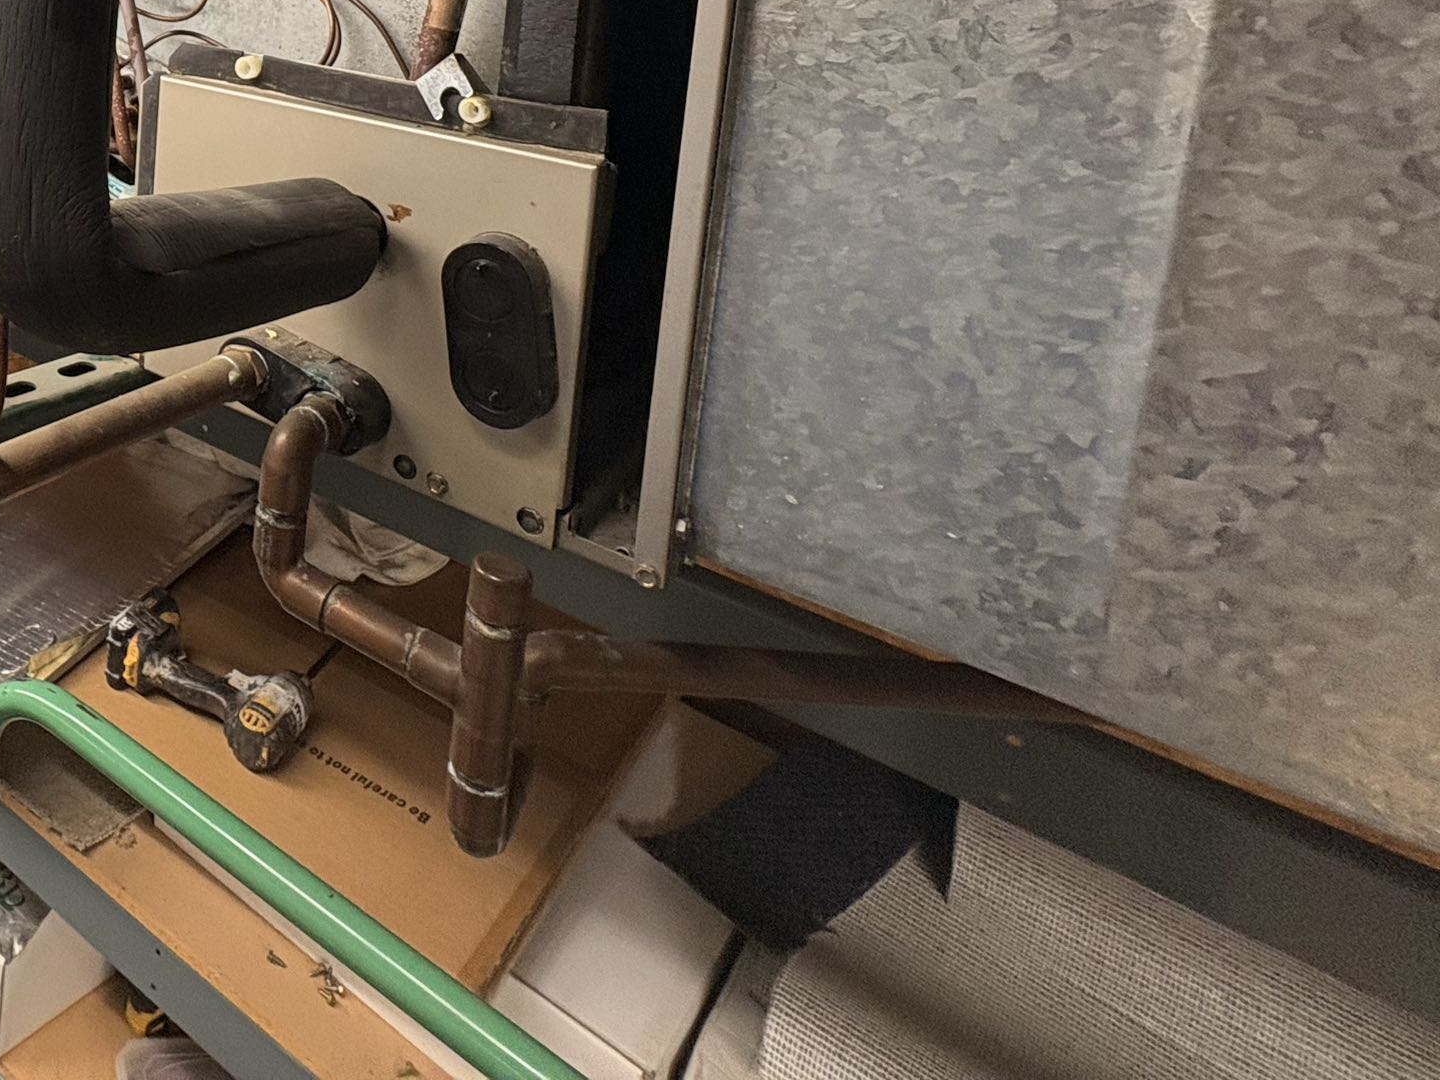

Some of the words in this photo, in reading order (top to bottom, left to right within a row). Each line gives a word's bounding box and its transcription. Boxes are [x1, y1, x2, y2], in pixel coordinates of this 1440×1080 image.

[308, 746, 325, 761] to
[325, 756, 352, 775] not
[350, 771, 407, 808] careful
[408, 806, 432, 825] Be
